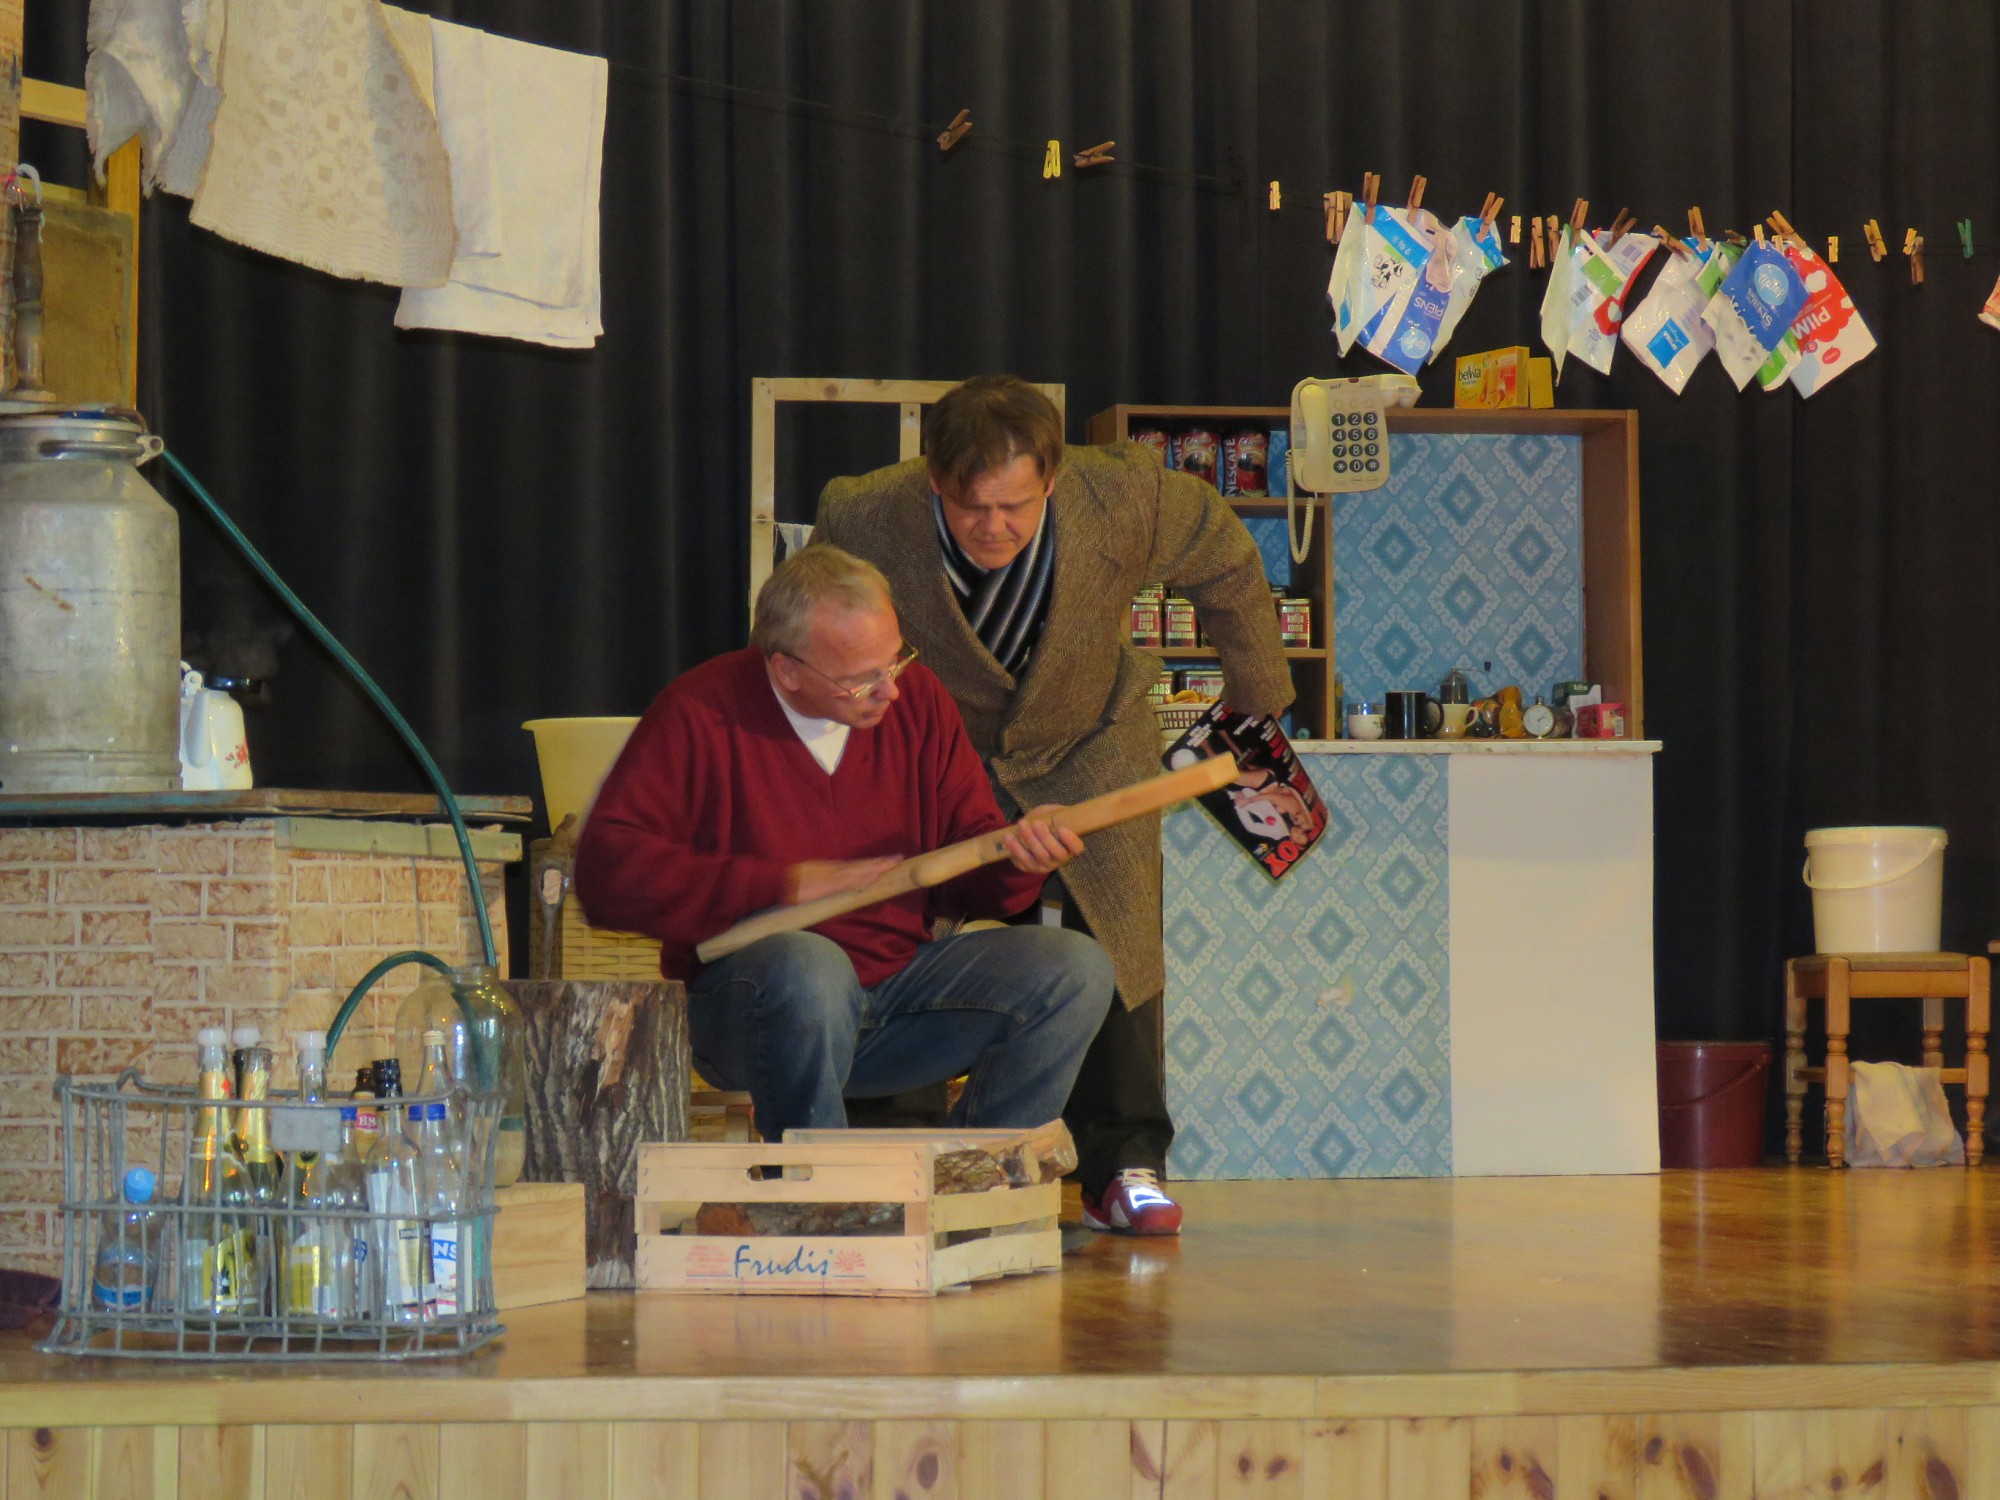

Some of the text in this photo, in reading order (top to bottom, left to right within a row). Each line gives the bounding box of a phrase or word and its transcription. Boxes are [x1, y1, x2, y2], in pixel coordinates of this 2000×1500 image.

[1414, 297, 1444, 317] PIENS
[1790, 306, 1832, 340] PIIM
[1336, 414, 1374, 424] 1 2 3
[1336, 430, 1375, 440] 4 5 6
[1337, 445, 1376, 456] 7 8 9
[1353, 462, 1361, 471] 0
[733, 1244, 828, 1278] Frudis
